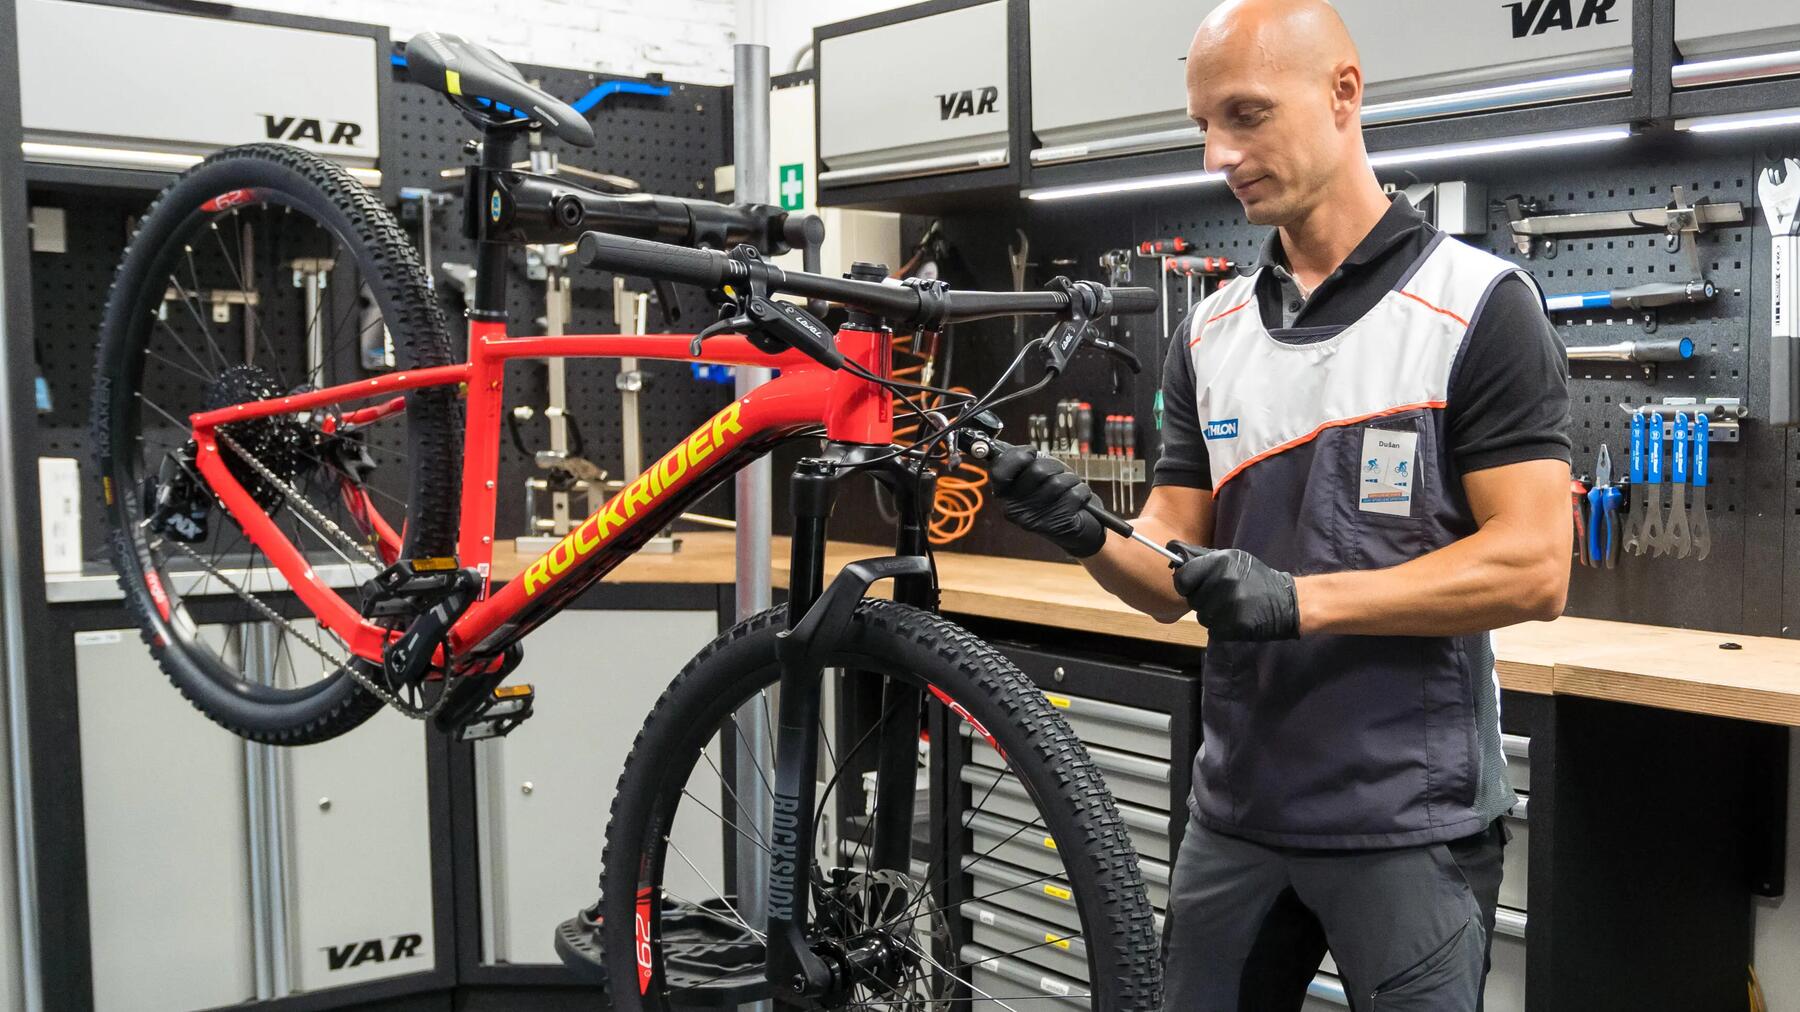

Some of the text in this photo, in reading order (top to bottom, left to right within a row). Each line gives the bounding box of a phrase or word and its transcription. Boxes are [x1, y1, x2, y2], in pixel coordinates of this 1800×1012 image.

[1502, 0, 1619, 39] VAR
[935, 86, 999, 121] VAR
[259, 114, 363, 145] VAR
[523, 402, 744, 596] ROCKRIDER
[767, 797, 799, 921] ROCKSHOX
[319, 933, 424, 971] VAR
[636, 912, 652, 969] 29
